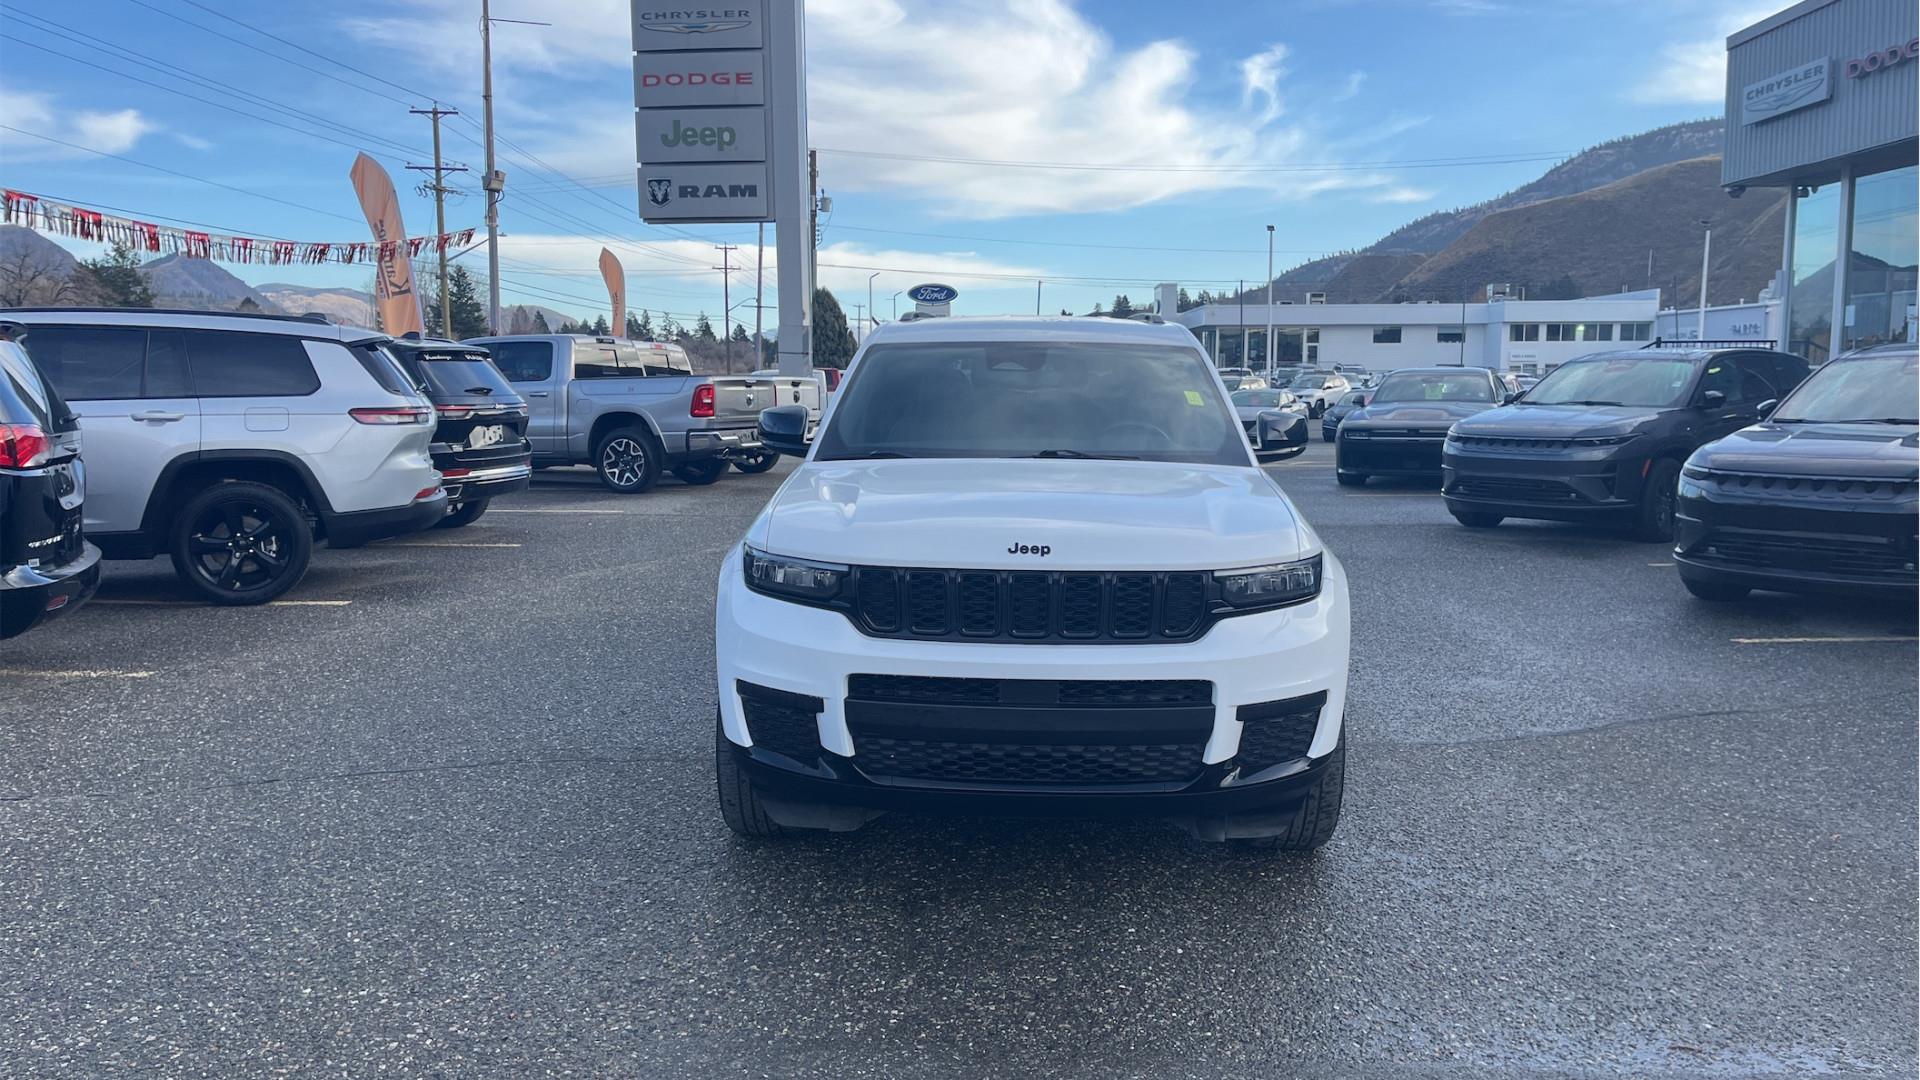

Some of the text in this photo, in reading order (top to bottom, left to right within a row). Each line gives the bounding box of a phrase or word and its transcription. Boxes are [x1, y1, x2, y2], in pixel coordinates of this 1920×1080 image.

[641, 9, 750, 21] CHRYSLER
[642, 72, 753, 88] DODGE
[1746, 64, 1824, 101] CHRYSLER
[660, 119, 736, 151] Jeep
[678, 184, 757, 198] RAM
[917, 287, 947, 300] Ford
[1007, 542, 1051, 557] Jeep
